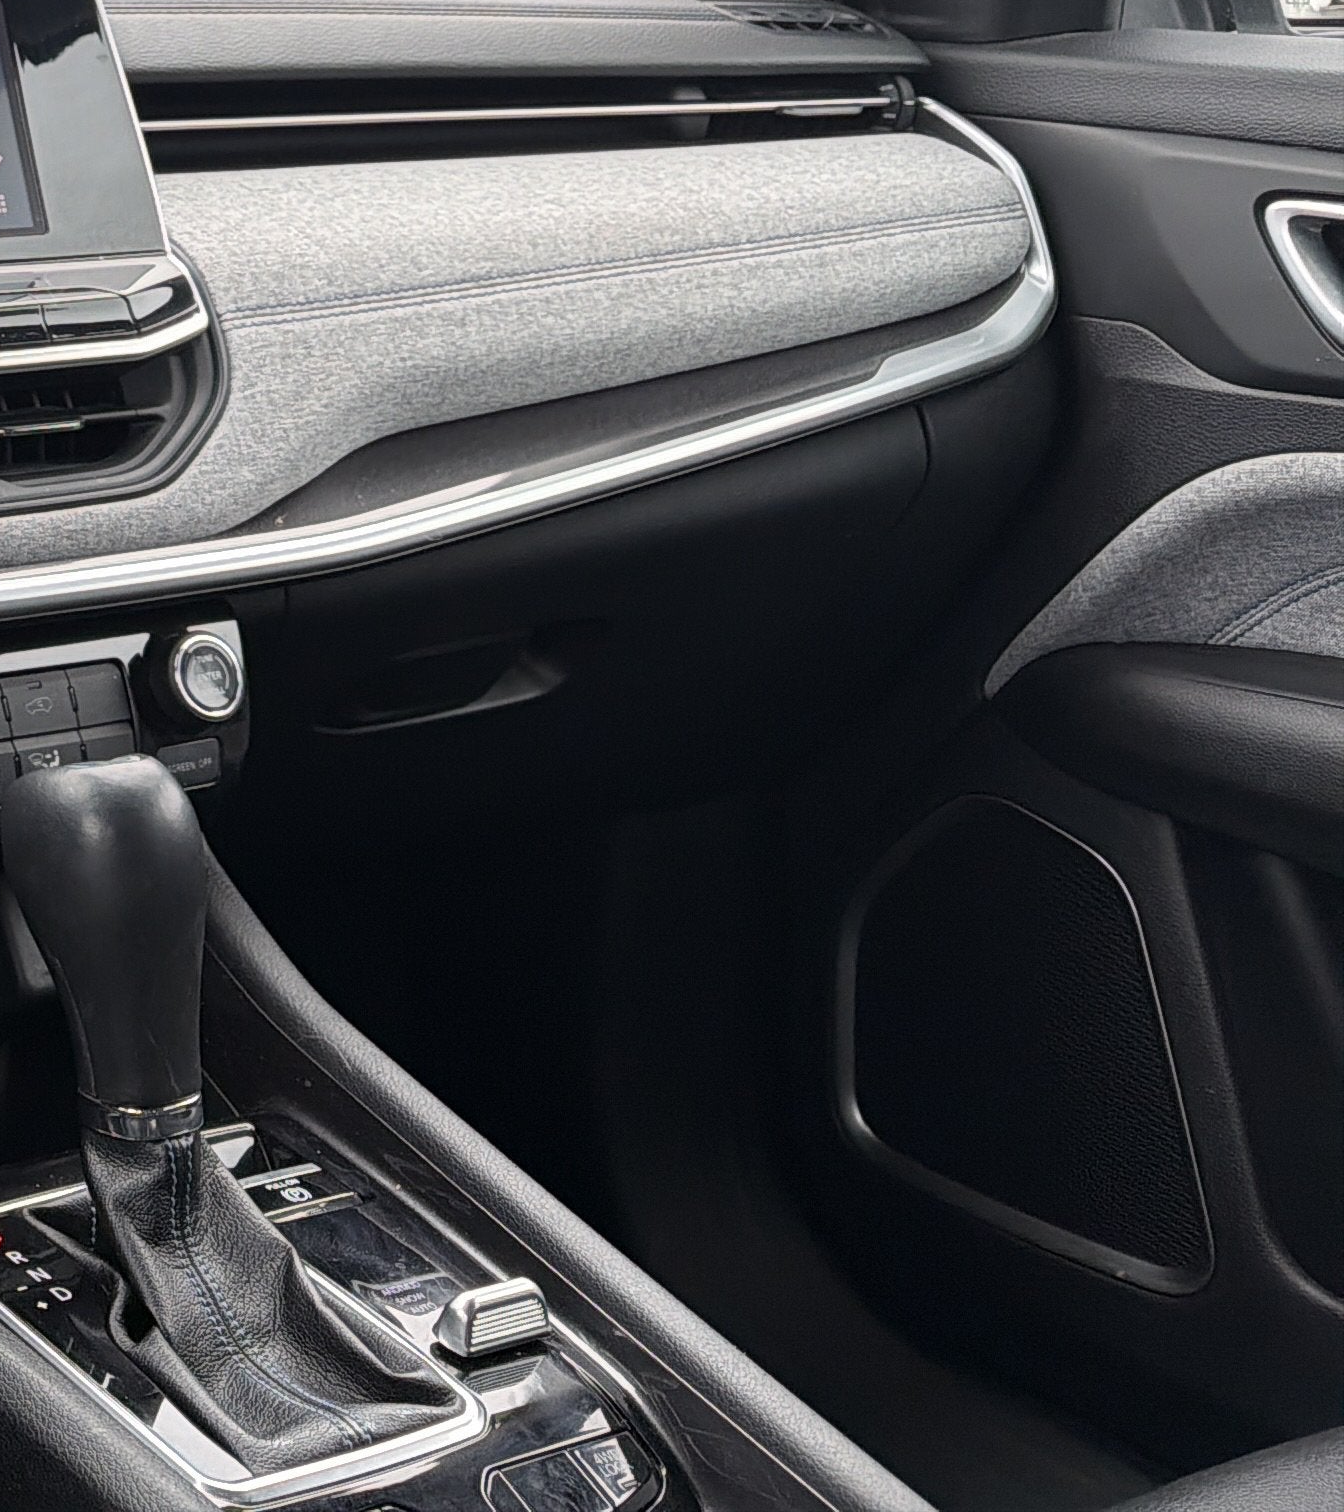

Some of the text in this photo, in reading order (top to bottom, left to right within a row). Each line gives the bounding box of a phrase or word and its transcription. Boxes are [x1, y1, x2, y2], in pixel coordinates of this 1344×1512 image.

[4, 1250, 30, 1266] R
[25, 1266, 53, 1283] N
[48, 1286, 73, 1302] D
[409, 1302, 439, 1314] AUTO
